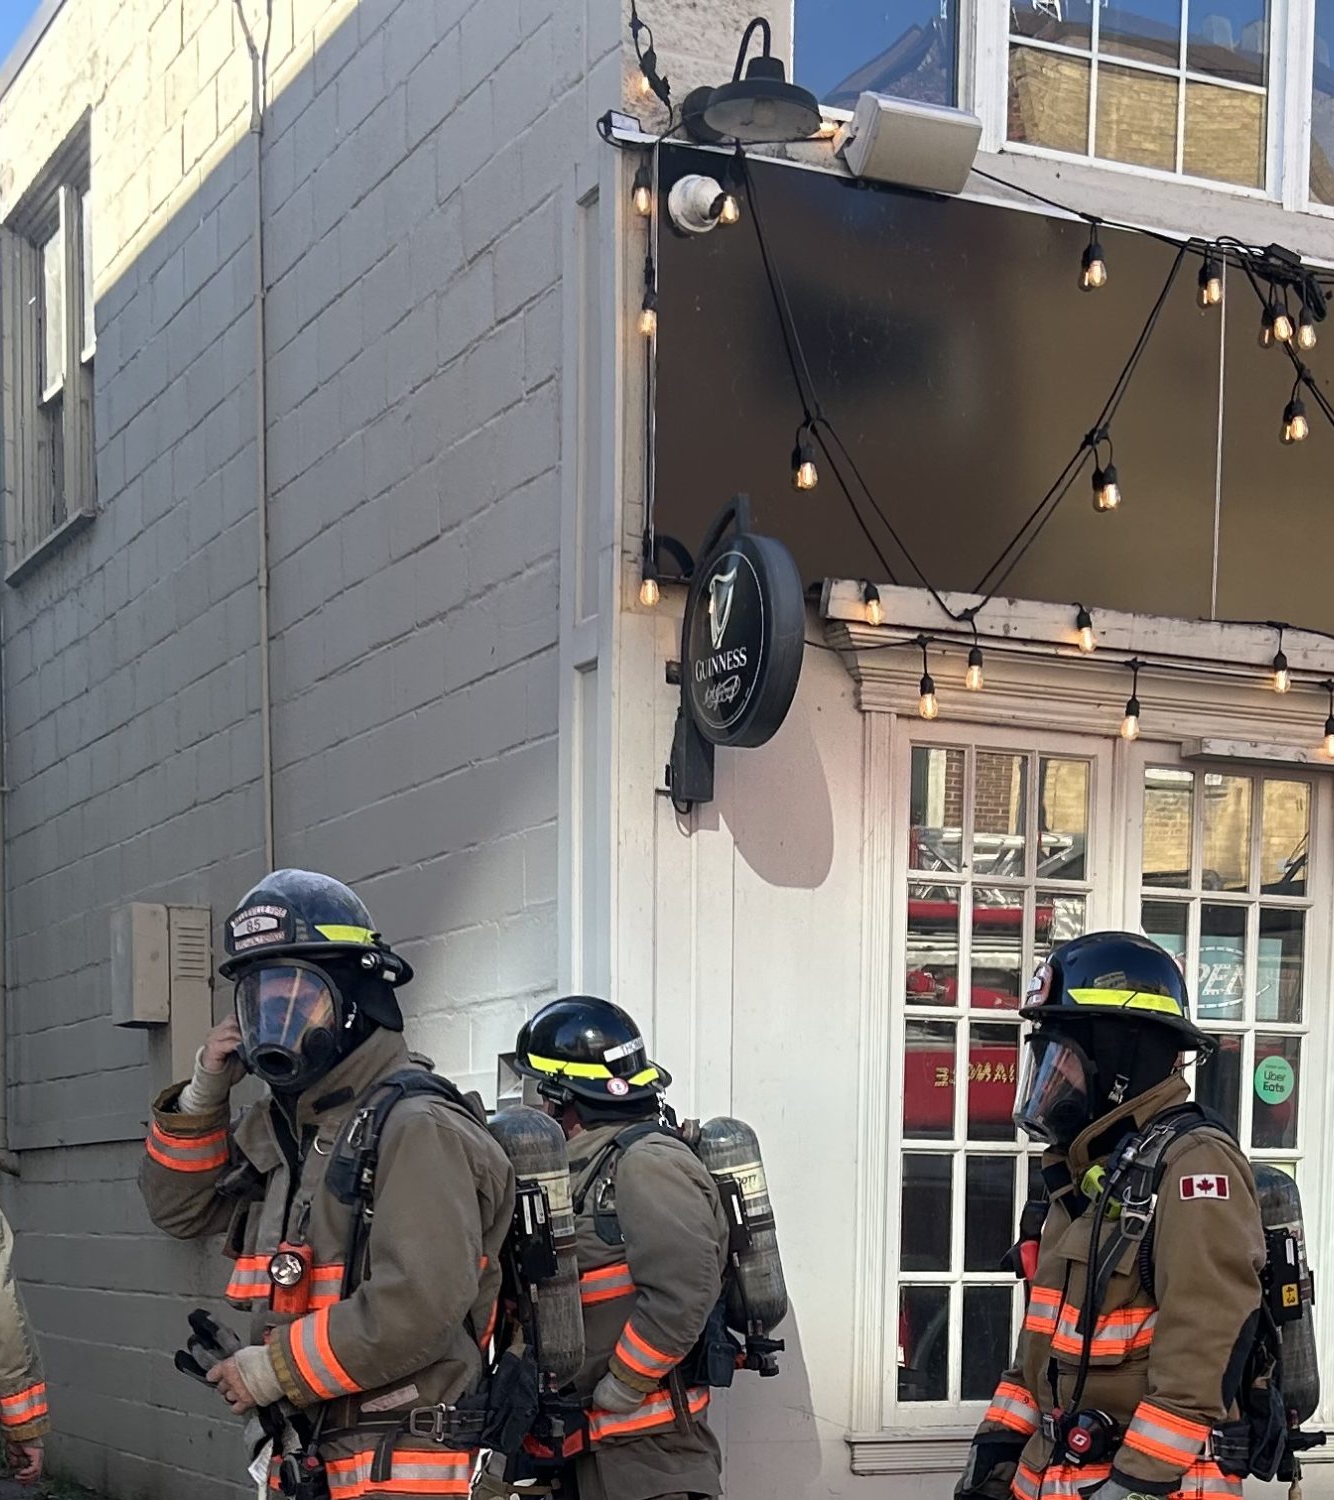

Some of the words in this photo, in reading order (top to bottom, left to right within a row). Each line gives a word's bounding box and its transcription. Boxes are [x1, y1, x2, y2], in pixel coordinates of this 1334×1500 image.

[694, 646, 748, 683] GUINNESS
[246, 919, 262, 934] 85
[1263, 1070, 1287, 1082] Uber
[1262, 1081, 1285, 1093] Eats
